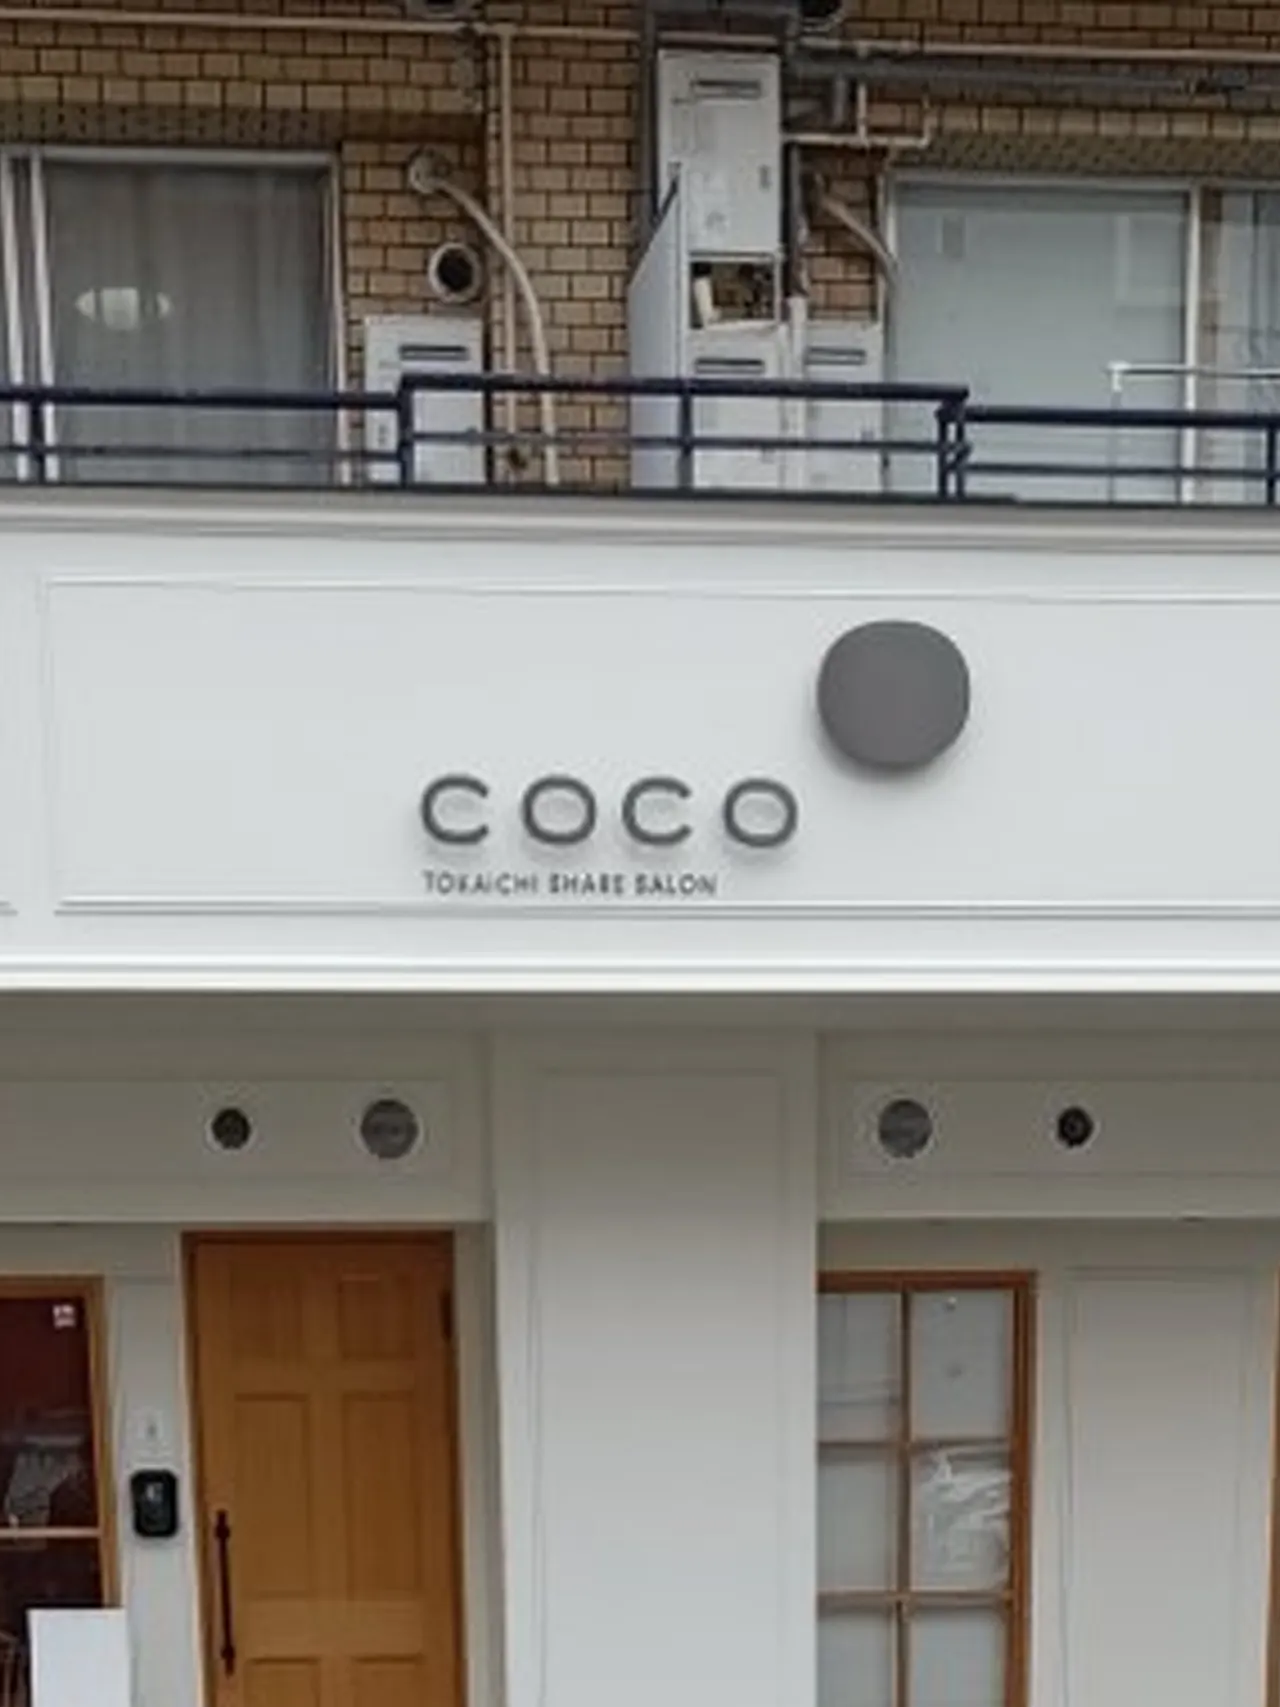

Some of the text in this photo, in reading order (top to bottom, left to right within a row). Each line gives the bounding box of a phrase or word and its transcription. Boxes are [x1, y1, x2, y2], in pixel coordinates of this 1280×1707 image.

[421, 774, 798, 848] COCO
[421, 869, 718, 898] TOKAICHI SHARE SALON
